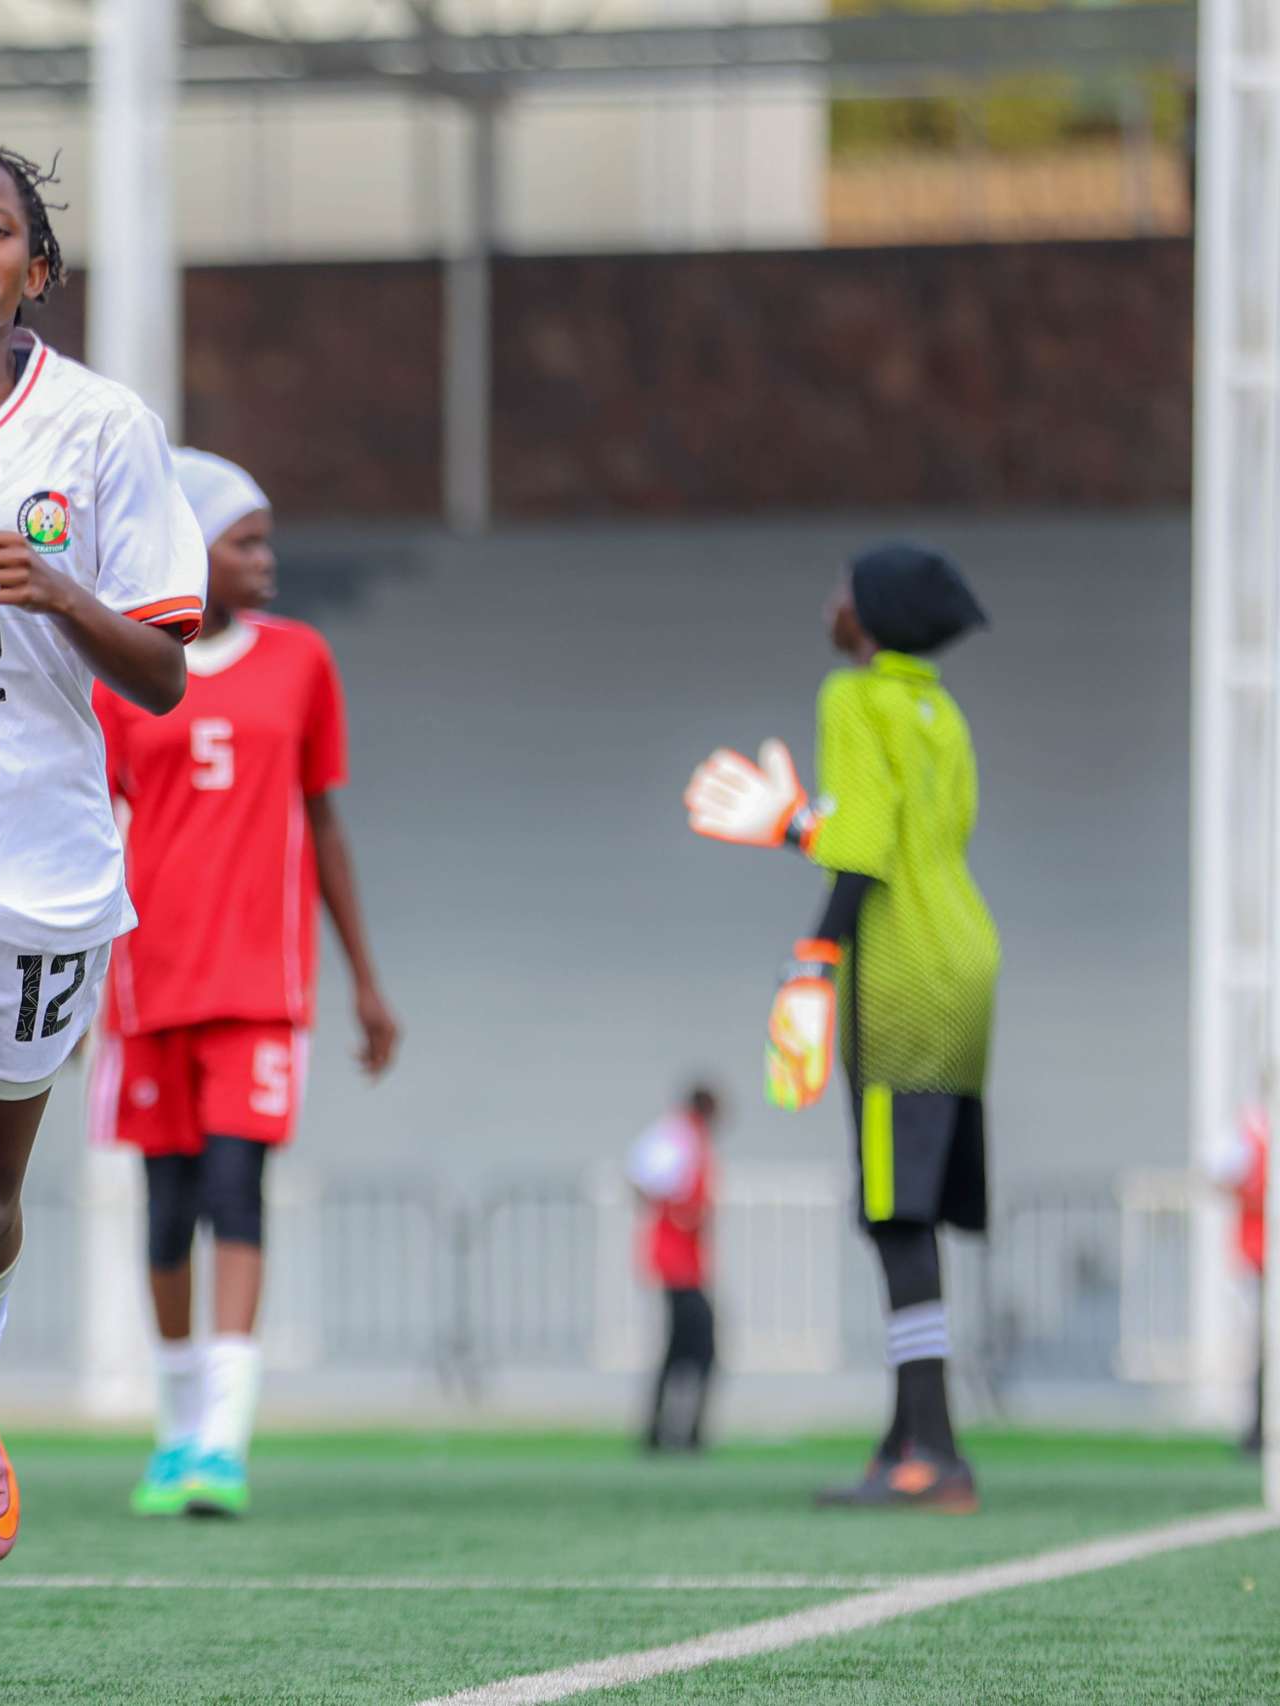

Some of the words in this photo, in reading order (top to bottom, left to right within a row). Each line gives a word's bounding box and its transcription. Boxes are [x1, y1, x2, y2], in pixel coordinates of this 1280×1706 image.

[190, 718, 234, 790] 5
[15, 951, 87, 1042] 12
[250, 1041, 290, 1117] 5
